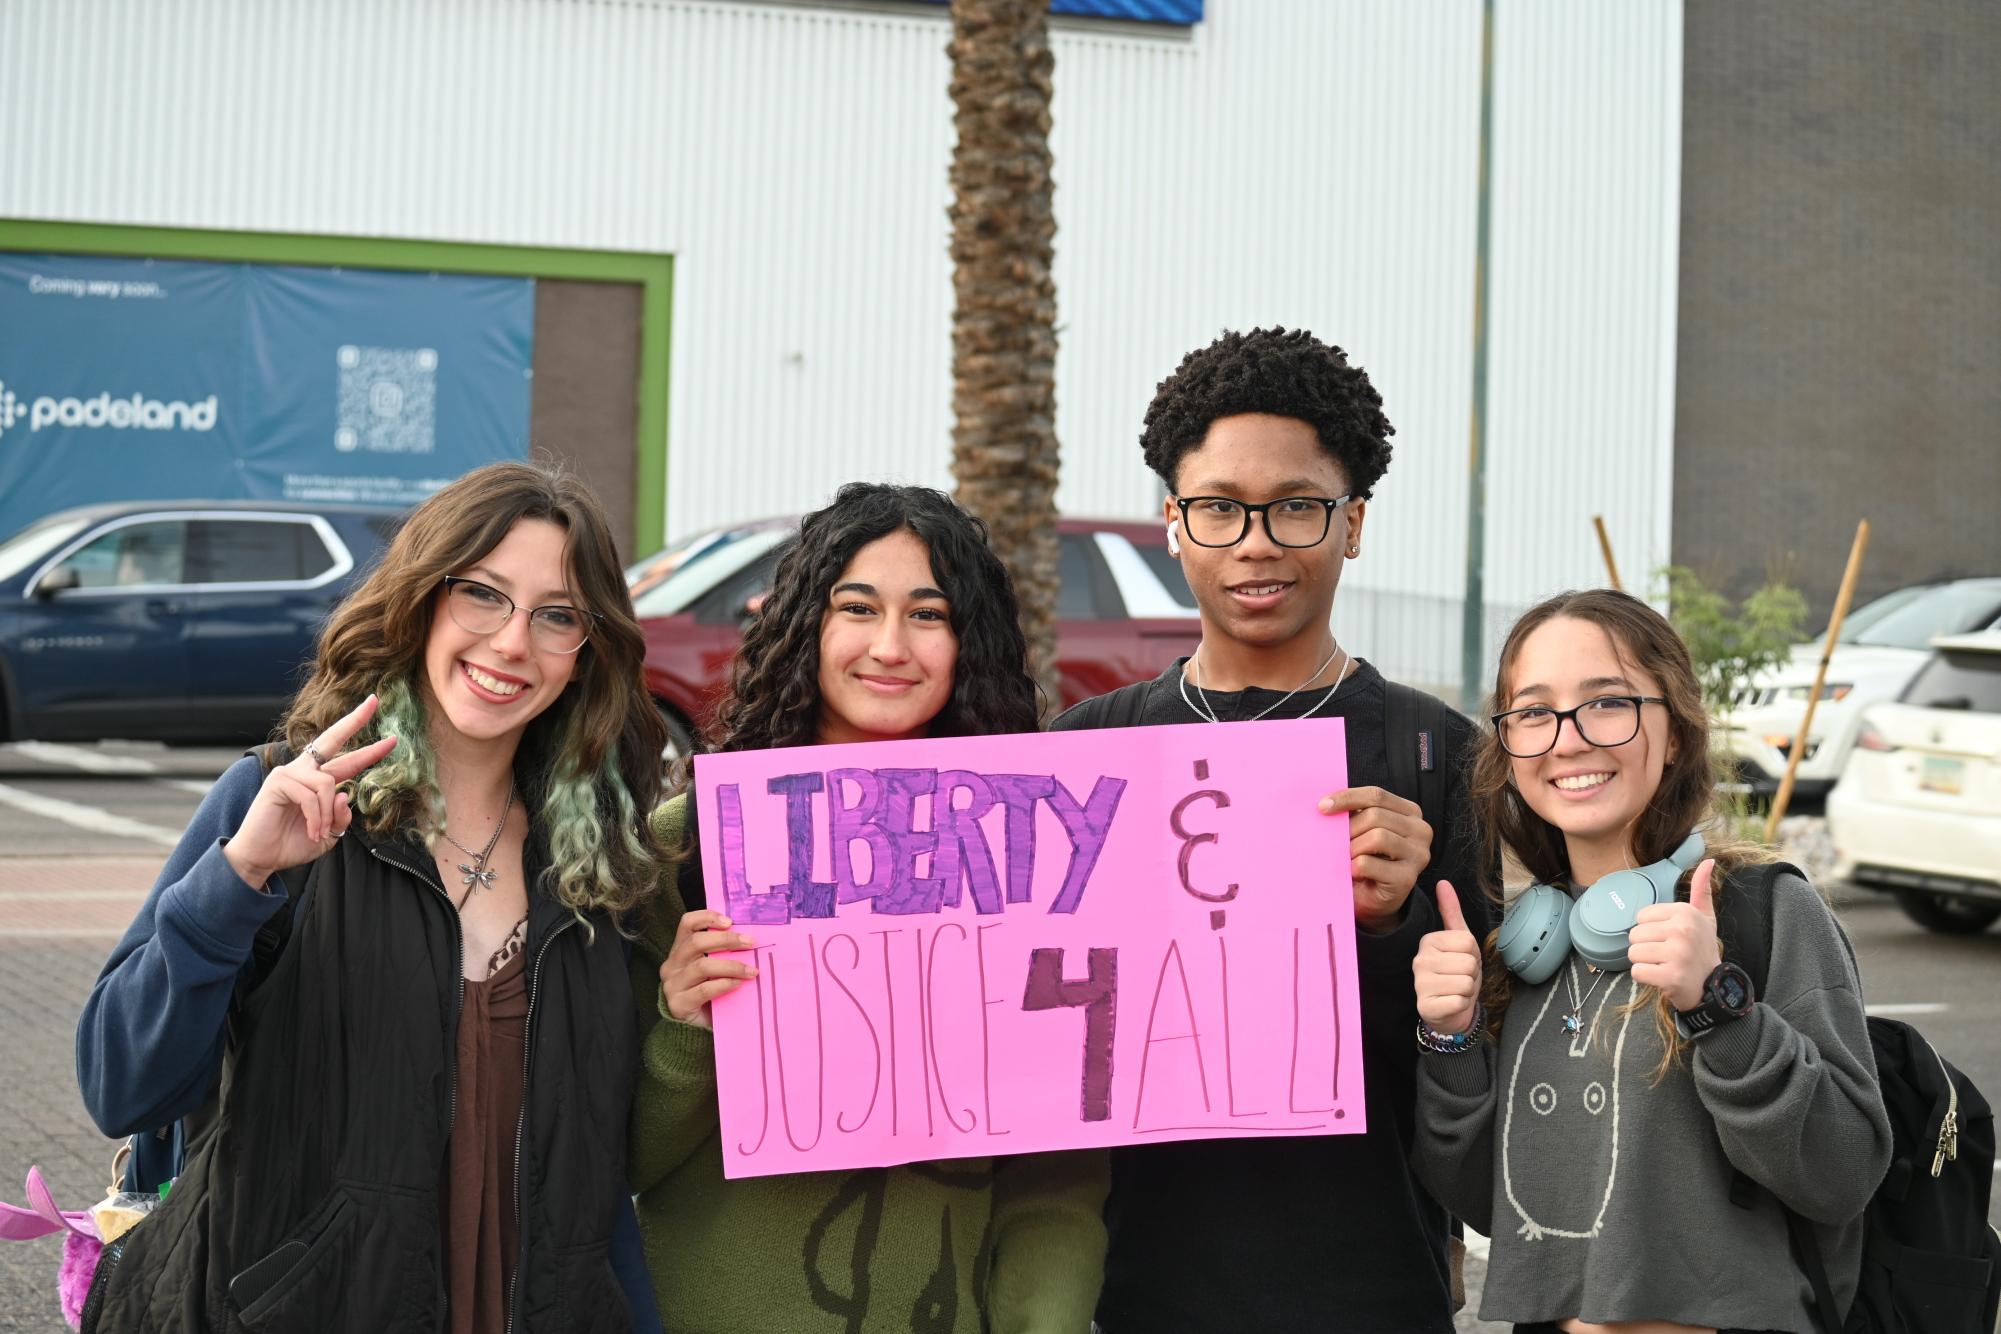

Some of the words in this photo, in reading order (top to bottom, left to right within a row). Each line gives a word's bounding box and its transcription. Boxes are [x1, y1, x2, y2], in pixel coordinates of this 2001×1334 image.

[29, 274, 86, 298] Coming
[87, 280, 120, 299] very
[30, 391, 218, 432] padeland
[716, 767, 1128, 926] LIBERTY
[1169, 758, 1239, 931] &
[738, 922, 1012, 1157] JUSTICE
[1020, 947, 1119, 1123] 4
[1133, 923, 1347, 1130] ALL!
